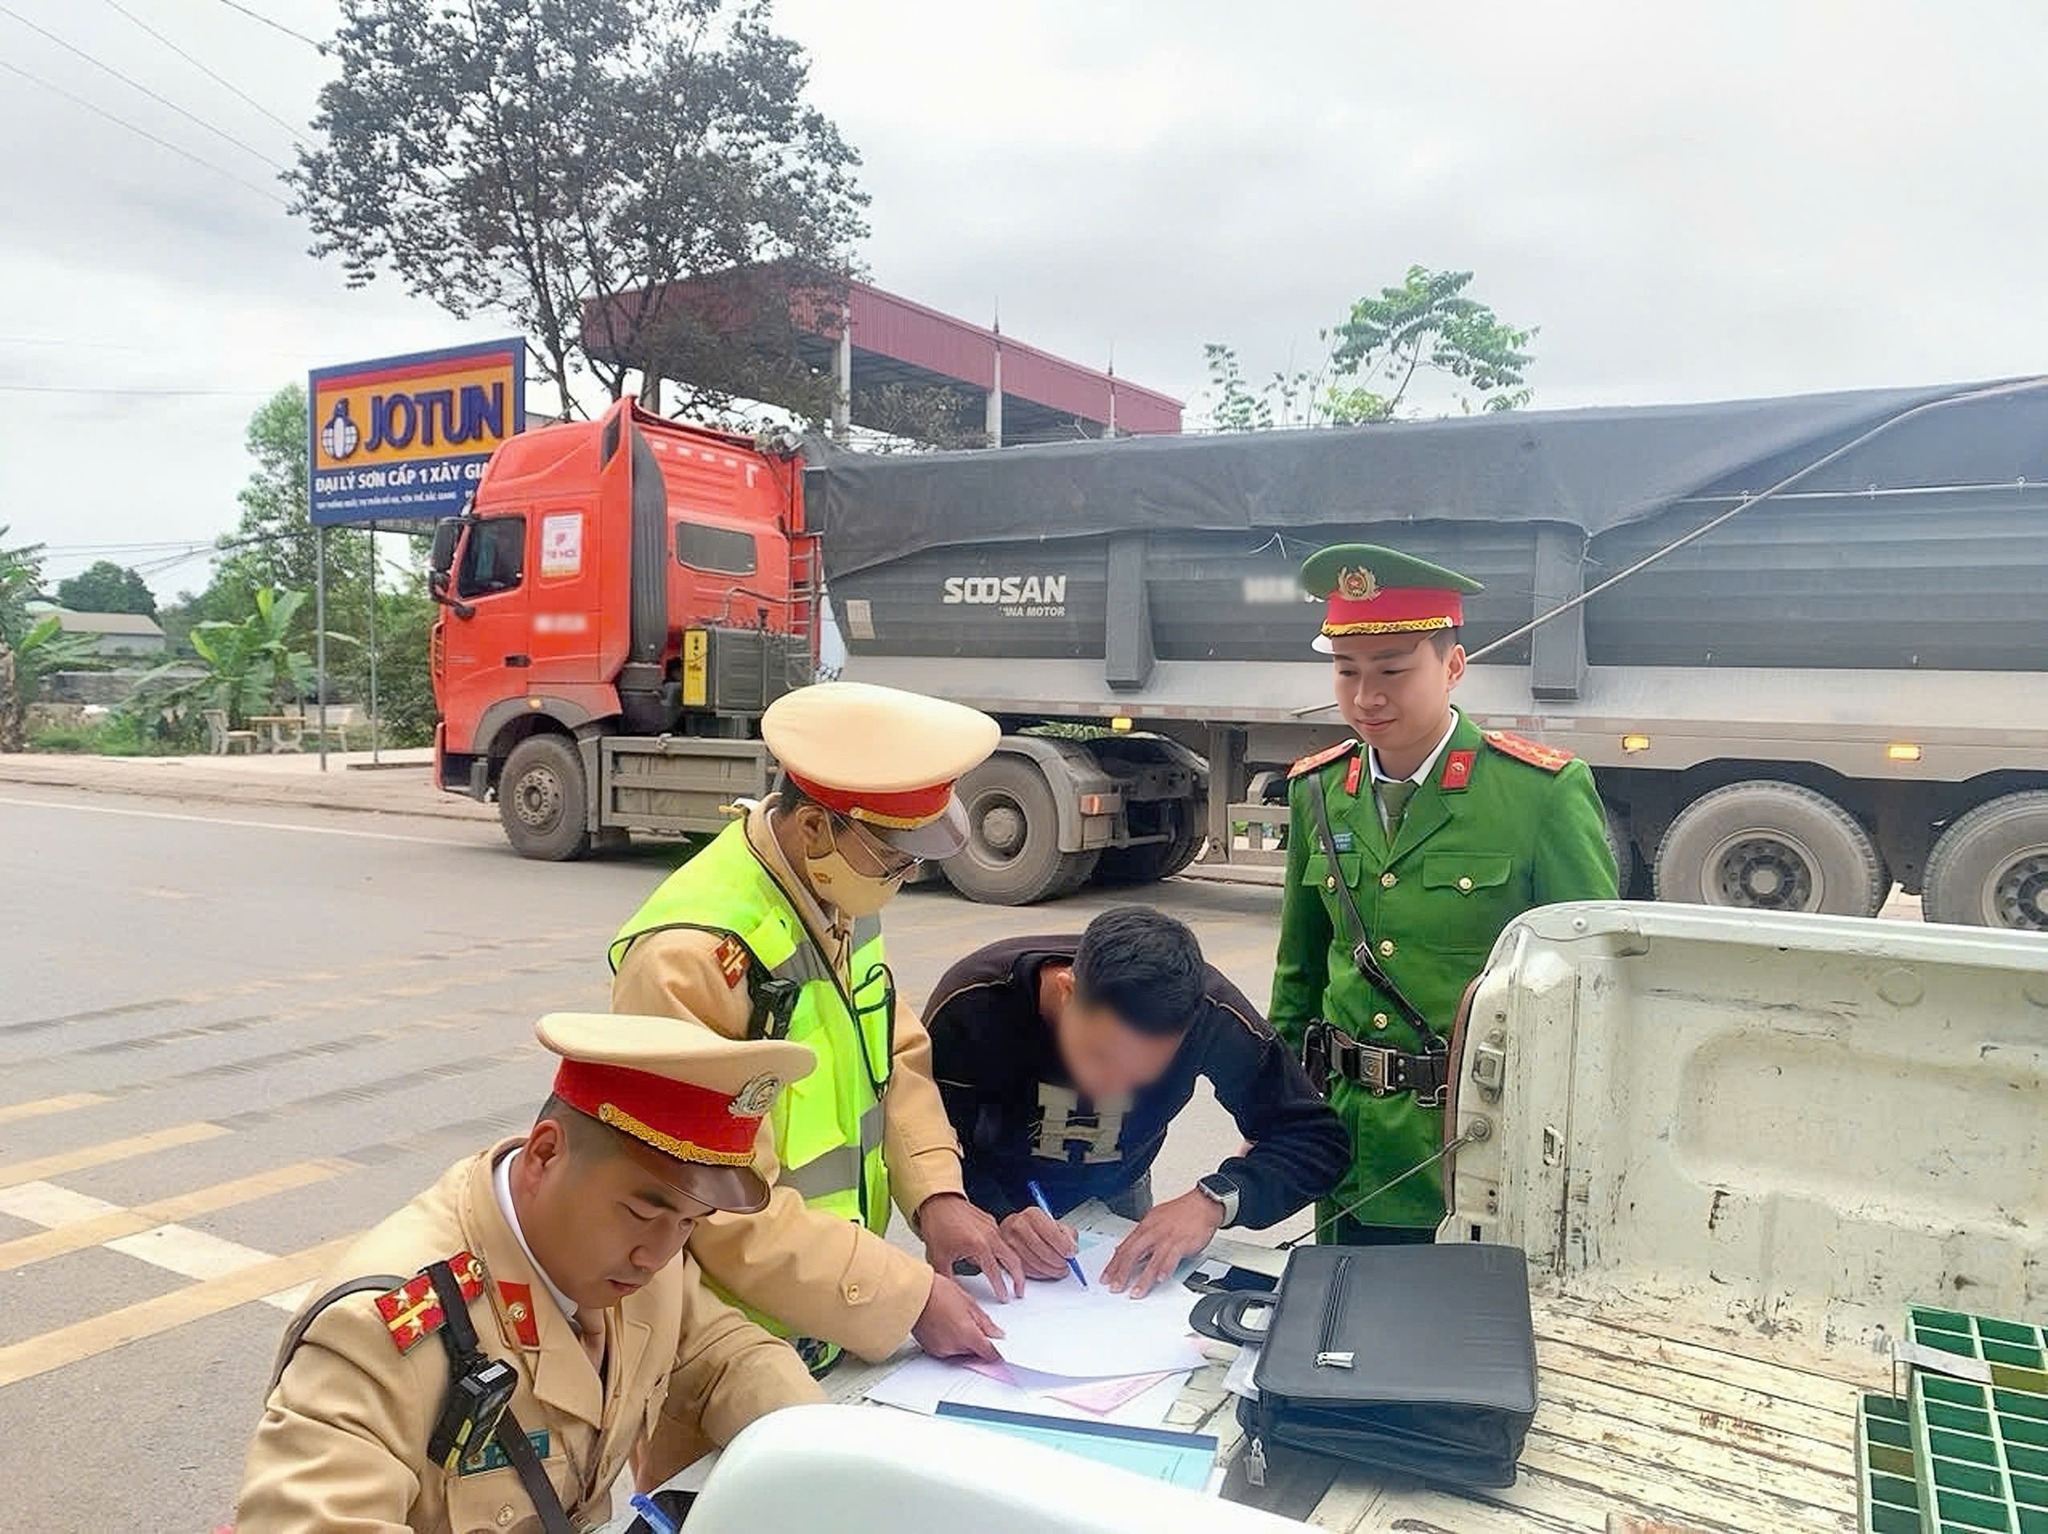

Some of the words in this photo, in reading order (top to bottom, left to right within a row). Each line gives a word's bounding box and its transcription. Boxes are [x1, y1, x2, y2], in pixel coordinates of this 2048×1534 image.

[364, 382, 504, 452] JOTUN
[315, 476, 339, 495] ĐẠI
[340, 470, 357, 491] LÝ
[358, 470, 387, 489] SƠN
[387, 463, 417, 486] CẤP
[418, 468, 428, 484] 1
[943, 575, 1067, 604] SOOSAN
[1026, 606, 1066, 617] MOTOR
